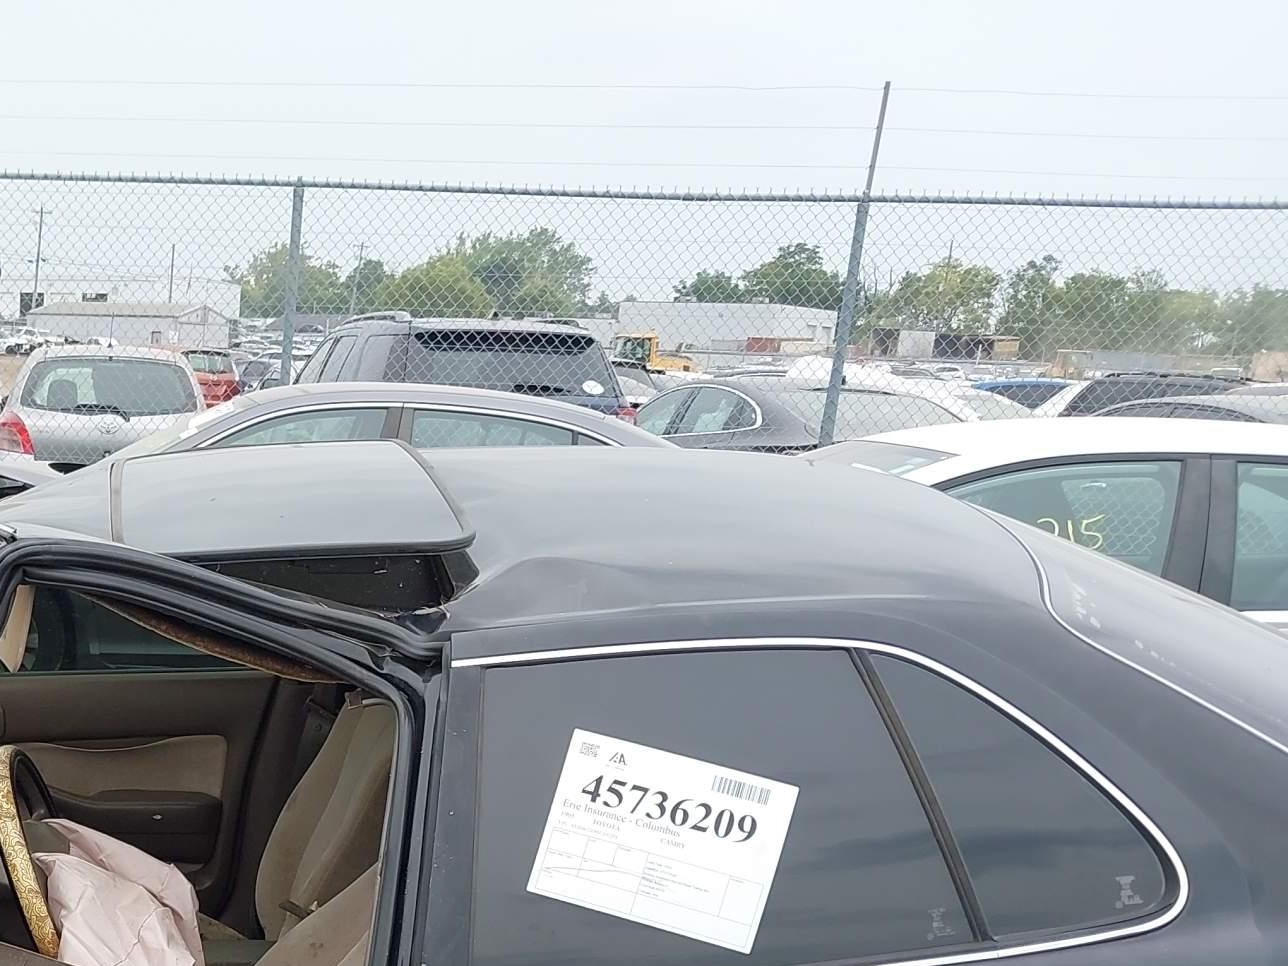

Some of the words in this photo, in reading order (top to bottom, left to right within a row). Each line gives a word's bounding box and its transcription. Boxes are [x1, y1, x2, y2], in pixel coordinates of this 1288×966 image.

[581, 775, 757, 842] 45736209
[584, 803, 628, 823] Insurance
[634, 818, 681, 838] Columbus
